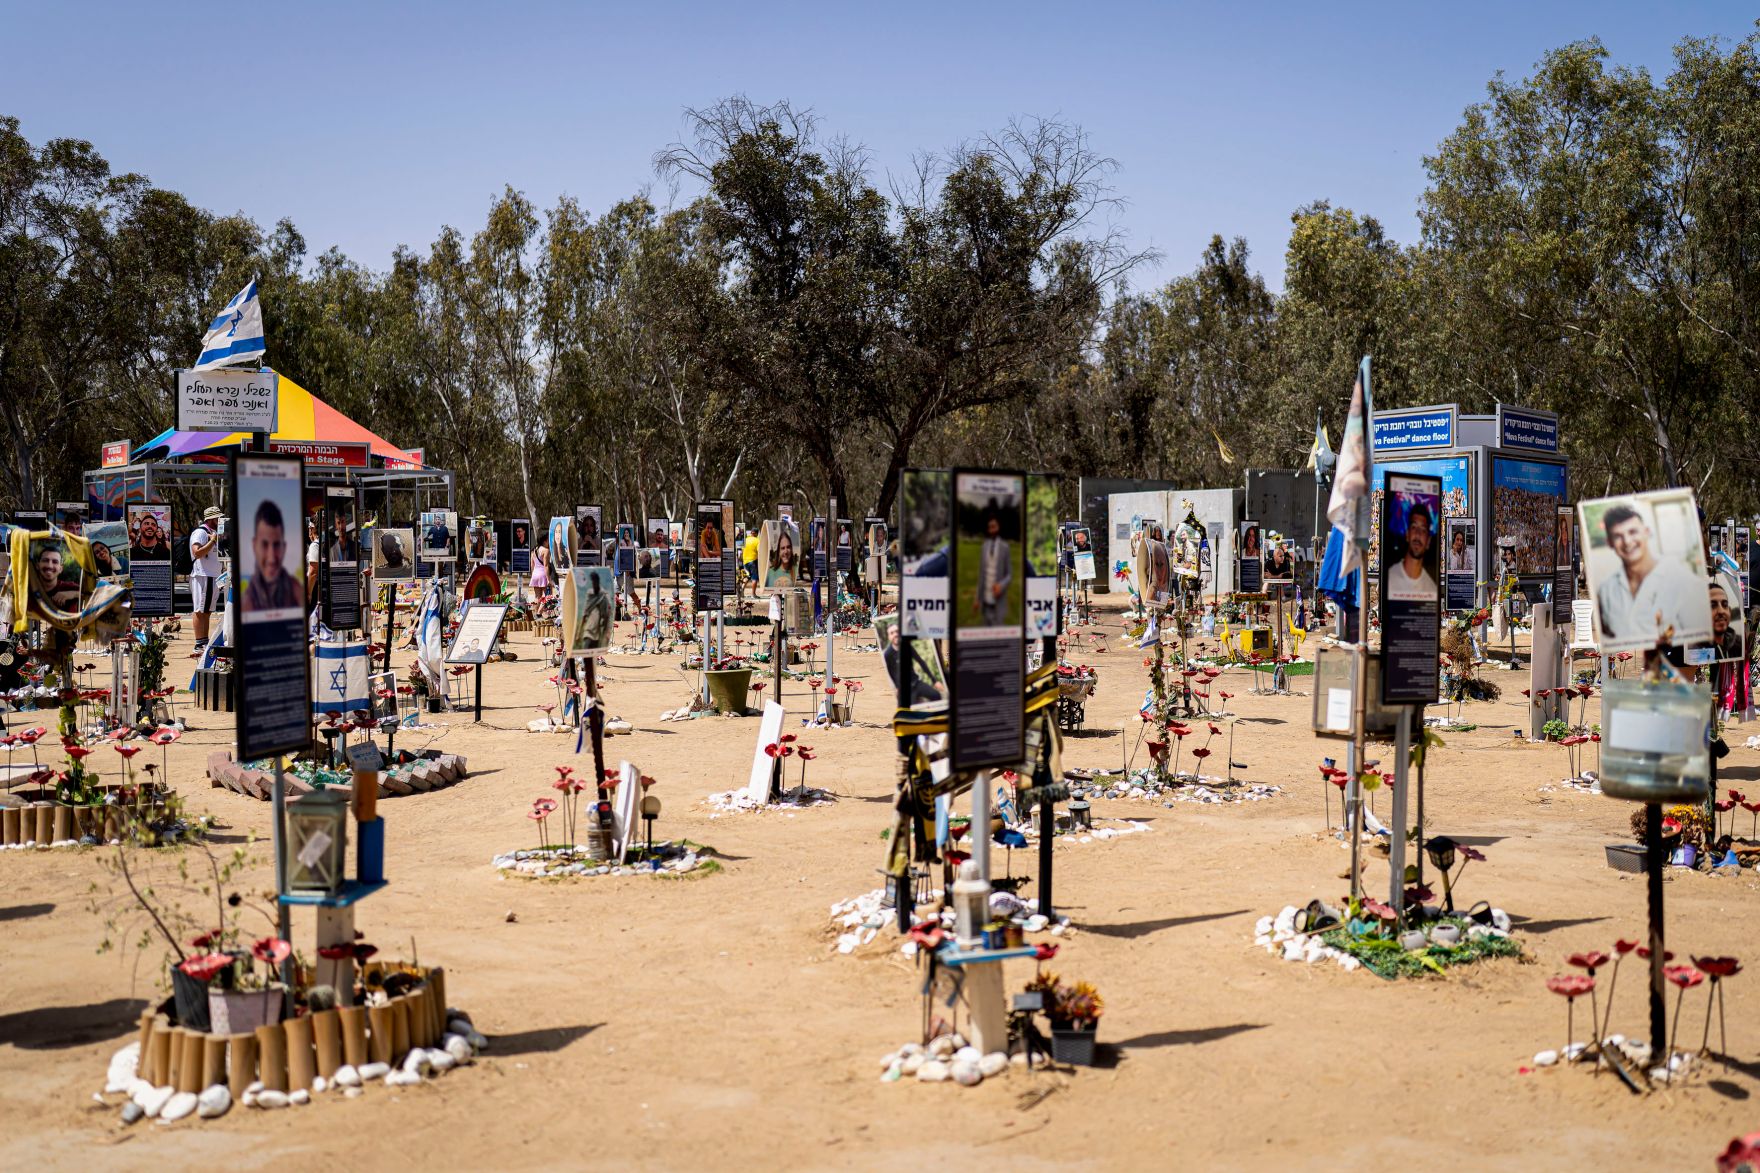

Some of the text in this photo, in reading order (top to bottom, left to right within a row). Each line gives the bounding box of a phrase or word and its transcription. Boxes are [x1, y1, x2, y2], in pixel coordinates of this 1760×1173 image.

[186, 380, 271, 398] בשבילי נברא העולם
[189, 397, 268, 411] ואנוכי עפר ואפר
[1390, 422, 1406, 431] רחבת
[1411, 434, 1431, 442] dance
[1432, 432, 1449, 441] floor
[1535, 437, 1547, 446] dance
[1546, 438, 1556, 447] floor
[276, 444, 338, 454] הבמה המרכזית
[317, 455, 345, 465] Stage
[907, 598, 951, 611] חמים
